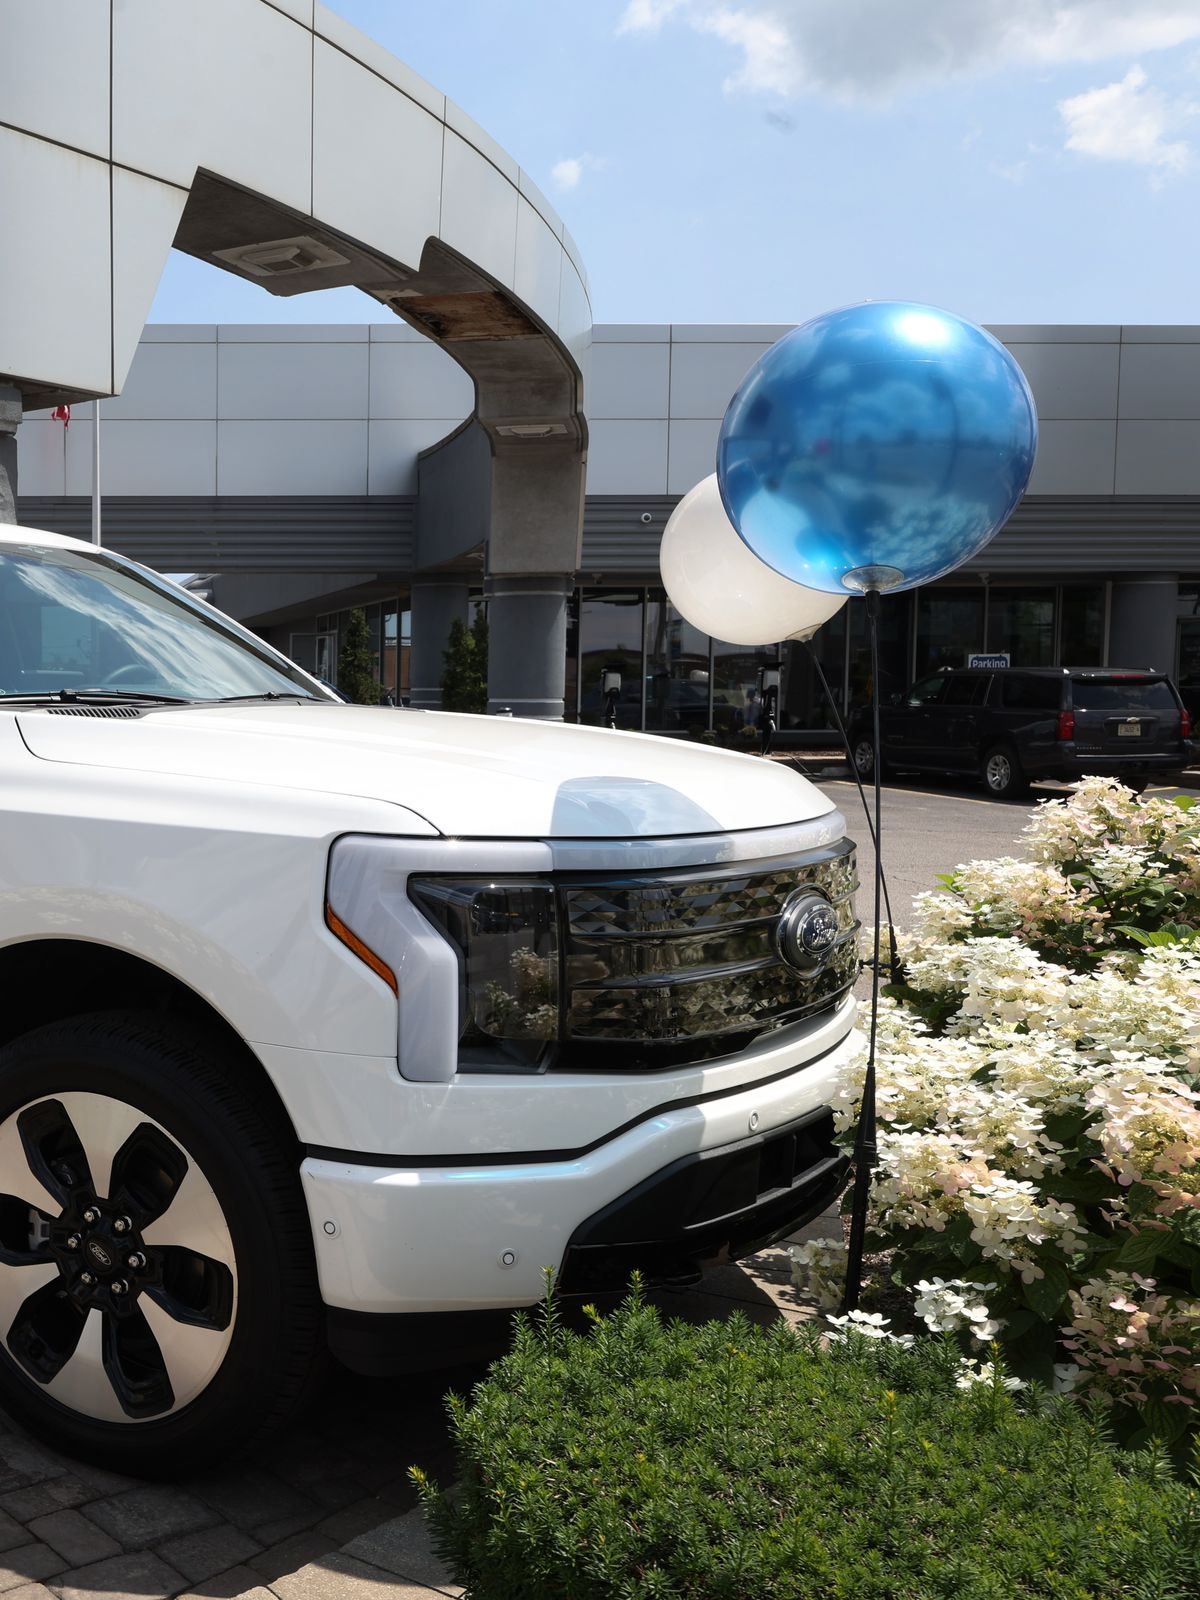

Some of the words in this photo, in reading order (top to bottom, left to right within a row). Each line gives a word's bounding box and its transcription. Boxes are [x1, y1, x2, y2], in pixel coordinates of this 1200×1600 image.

[972, 659, 1006, 669] Parking
[810, 914, 836, 945] Ford
[91, 1245, 108, 1262] Ford
